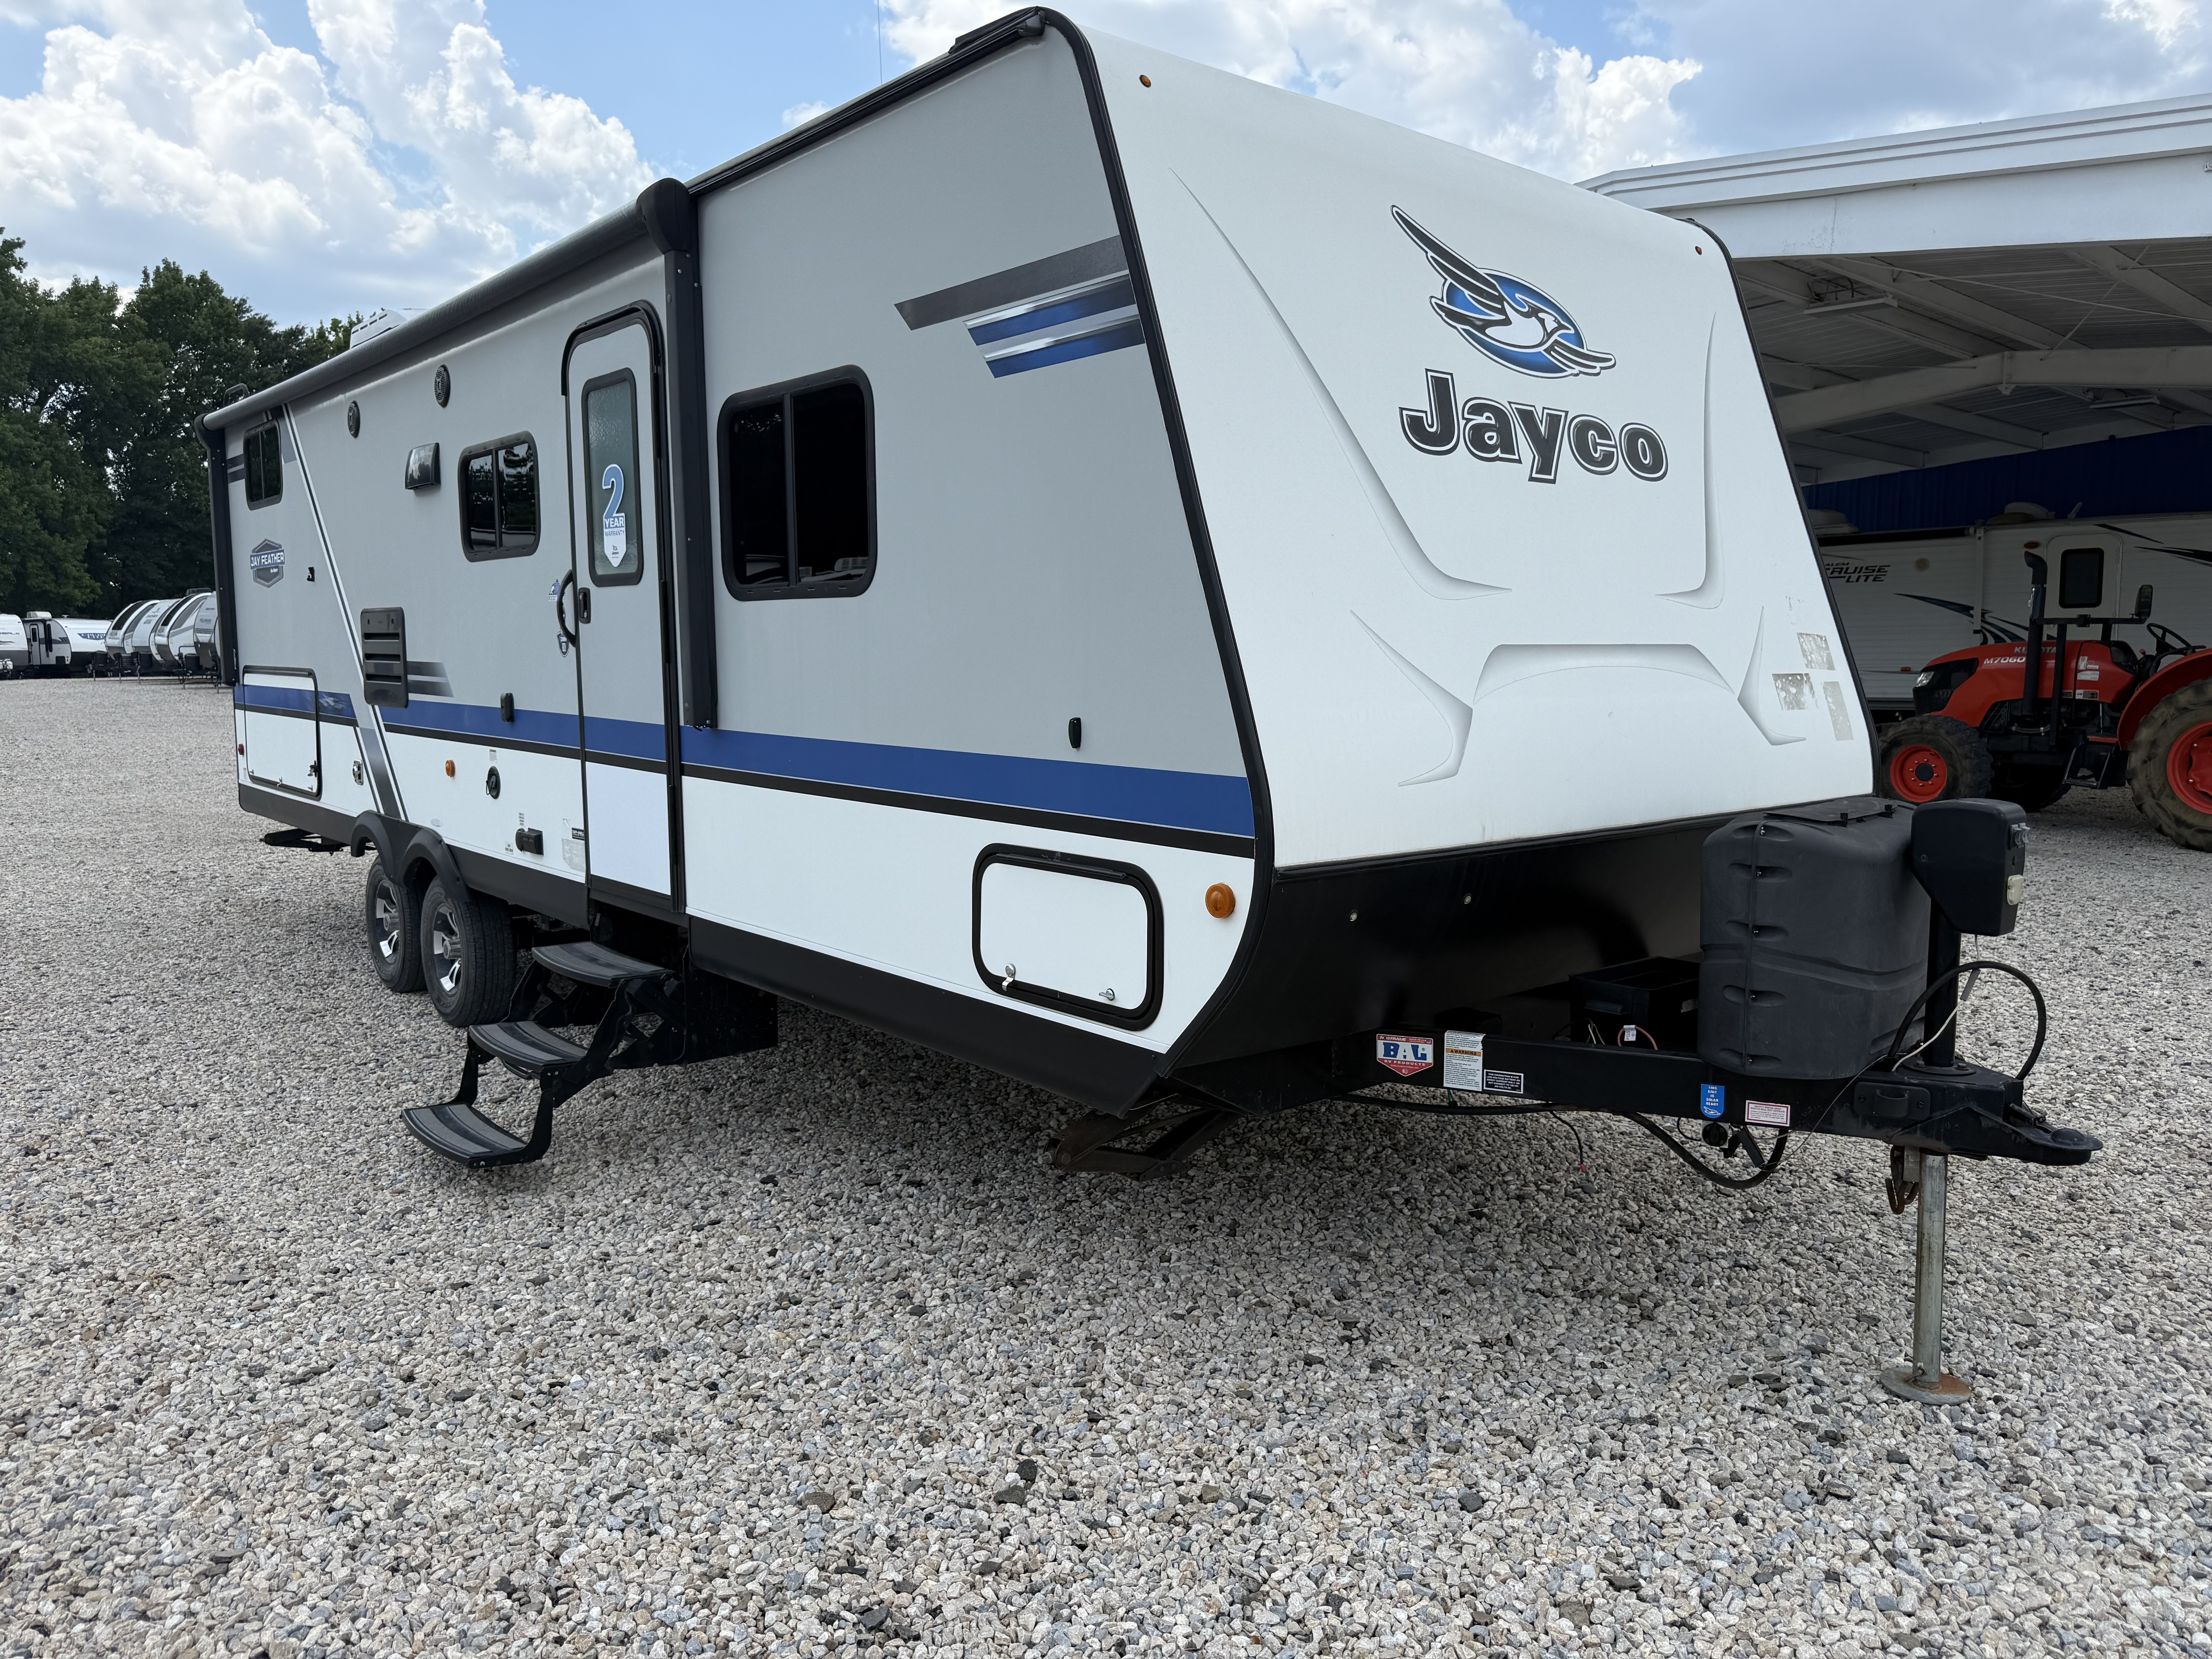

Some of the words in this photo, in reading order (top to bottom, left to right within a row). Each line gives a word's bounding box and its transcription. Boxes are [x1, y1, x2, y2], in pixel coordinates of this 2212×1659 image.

[1398, 368, 1668, 484] Jayco
[602, 464, 625, 518] 2
[605, 517, 624, 528] YEAR
[251, 556, 260, 567] JAY
[261, 552, 284, 565] FEATHER
[1845, 574, 1887, 583] LITE
[1383, 1042, 1427, 1061] BAL
